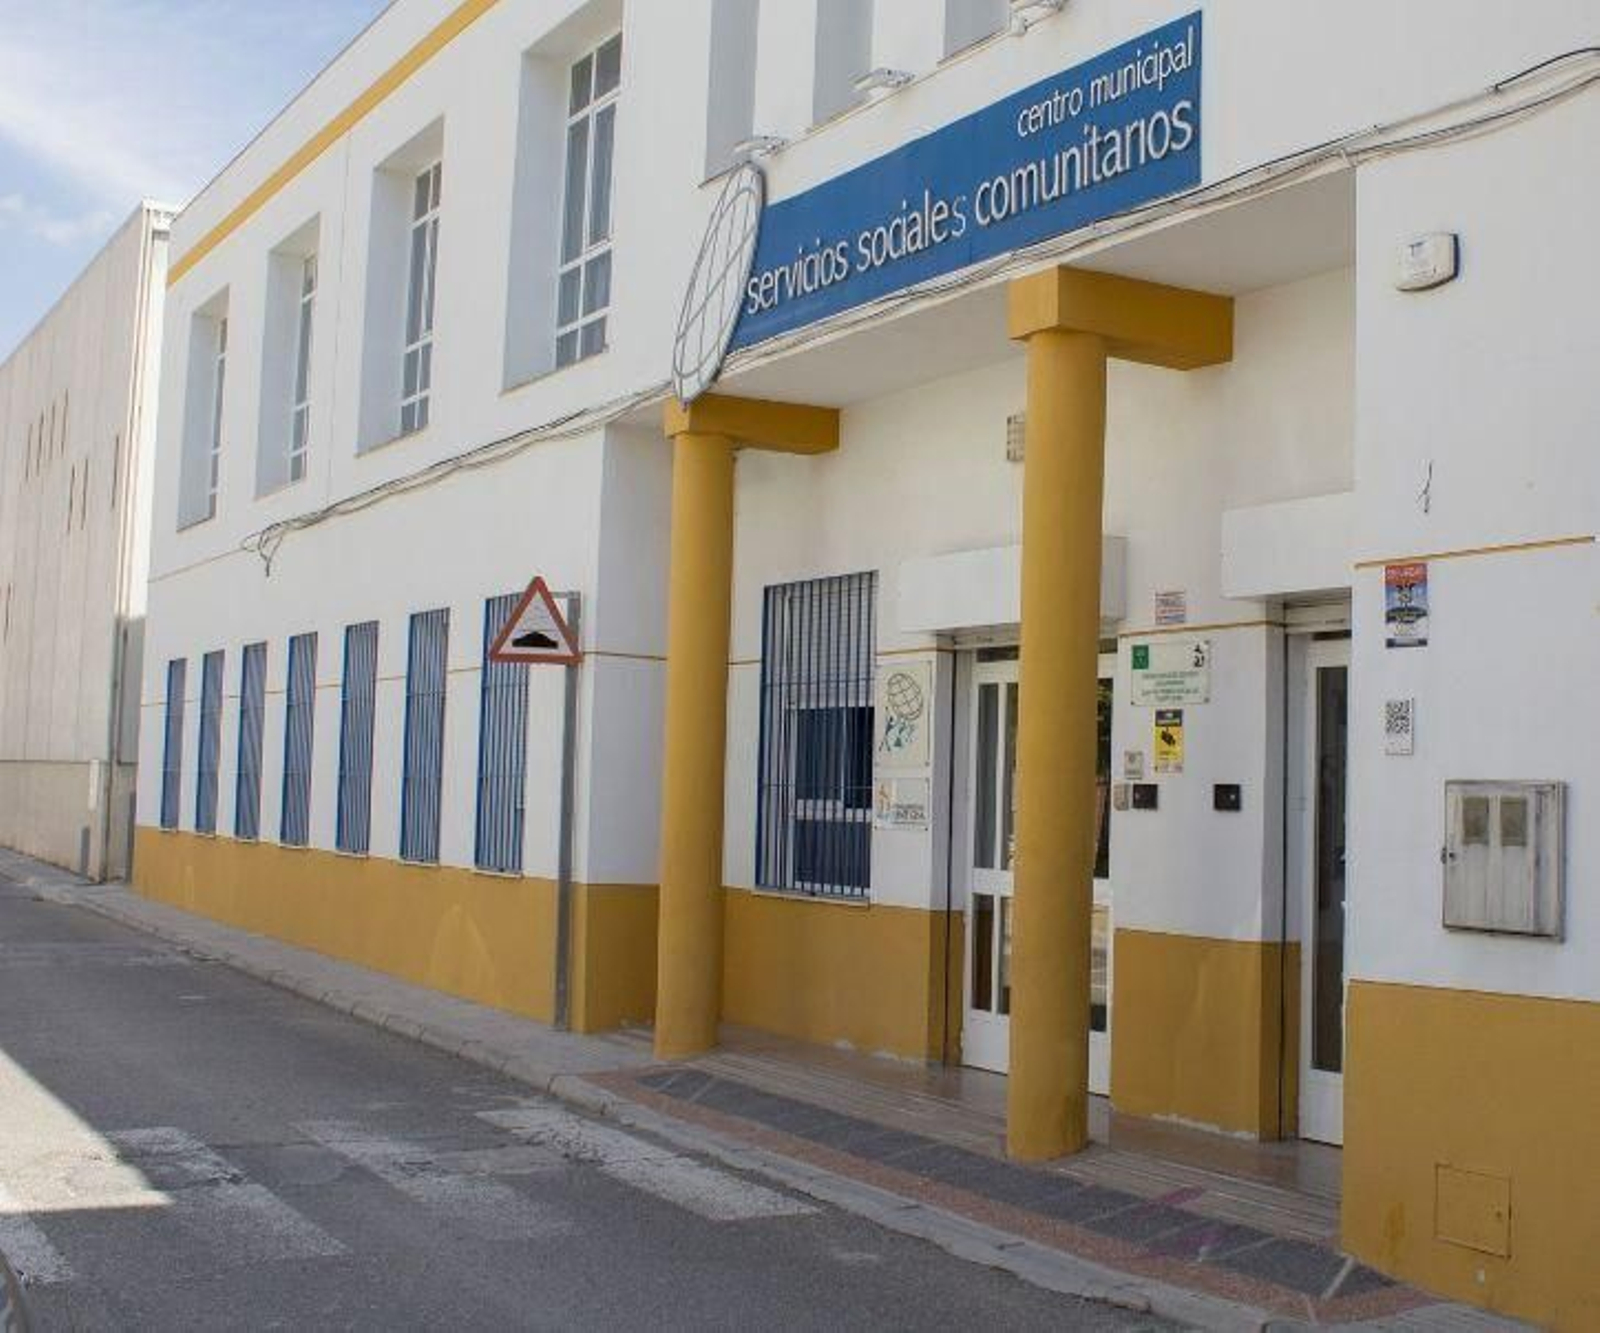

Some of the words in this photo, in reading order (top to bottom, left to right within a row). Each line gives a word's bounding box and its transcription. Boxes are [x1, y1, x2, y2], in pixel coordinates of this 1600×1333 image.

[1018, 86, 1082, 137] centro
[1090, 26, 1193, 107] municipal
[747, 238, 848, 314] servicios
[858, 190, 967, 272] sociales
[975, 101, 1193, 226] comunitarios
